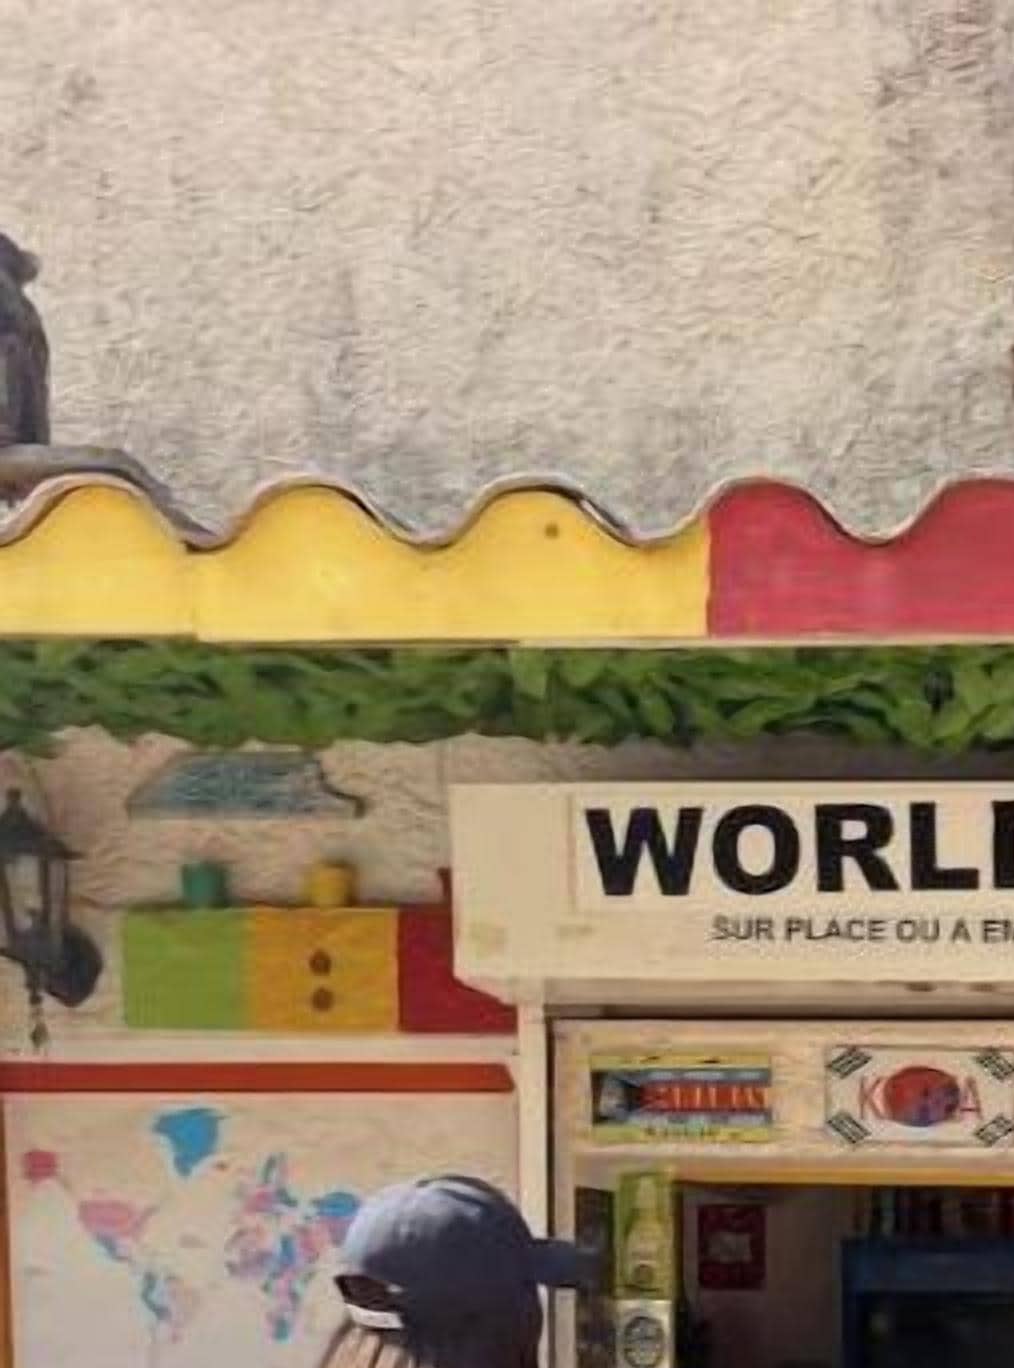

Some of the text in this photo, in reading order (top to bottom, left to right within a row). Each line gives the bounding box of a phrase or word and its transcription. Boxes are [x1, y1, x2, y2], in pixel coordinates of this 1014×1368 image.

[711, 914, 775, 942] SUR
[784, 917, 888, 942] PLACE
[895, 918, 941, 943] OU
[951, 919, 973, 943] A
